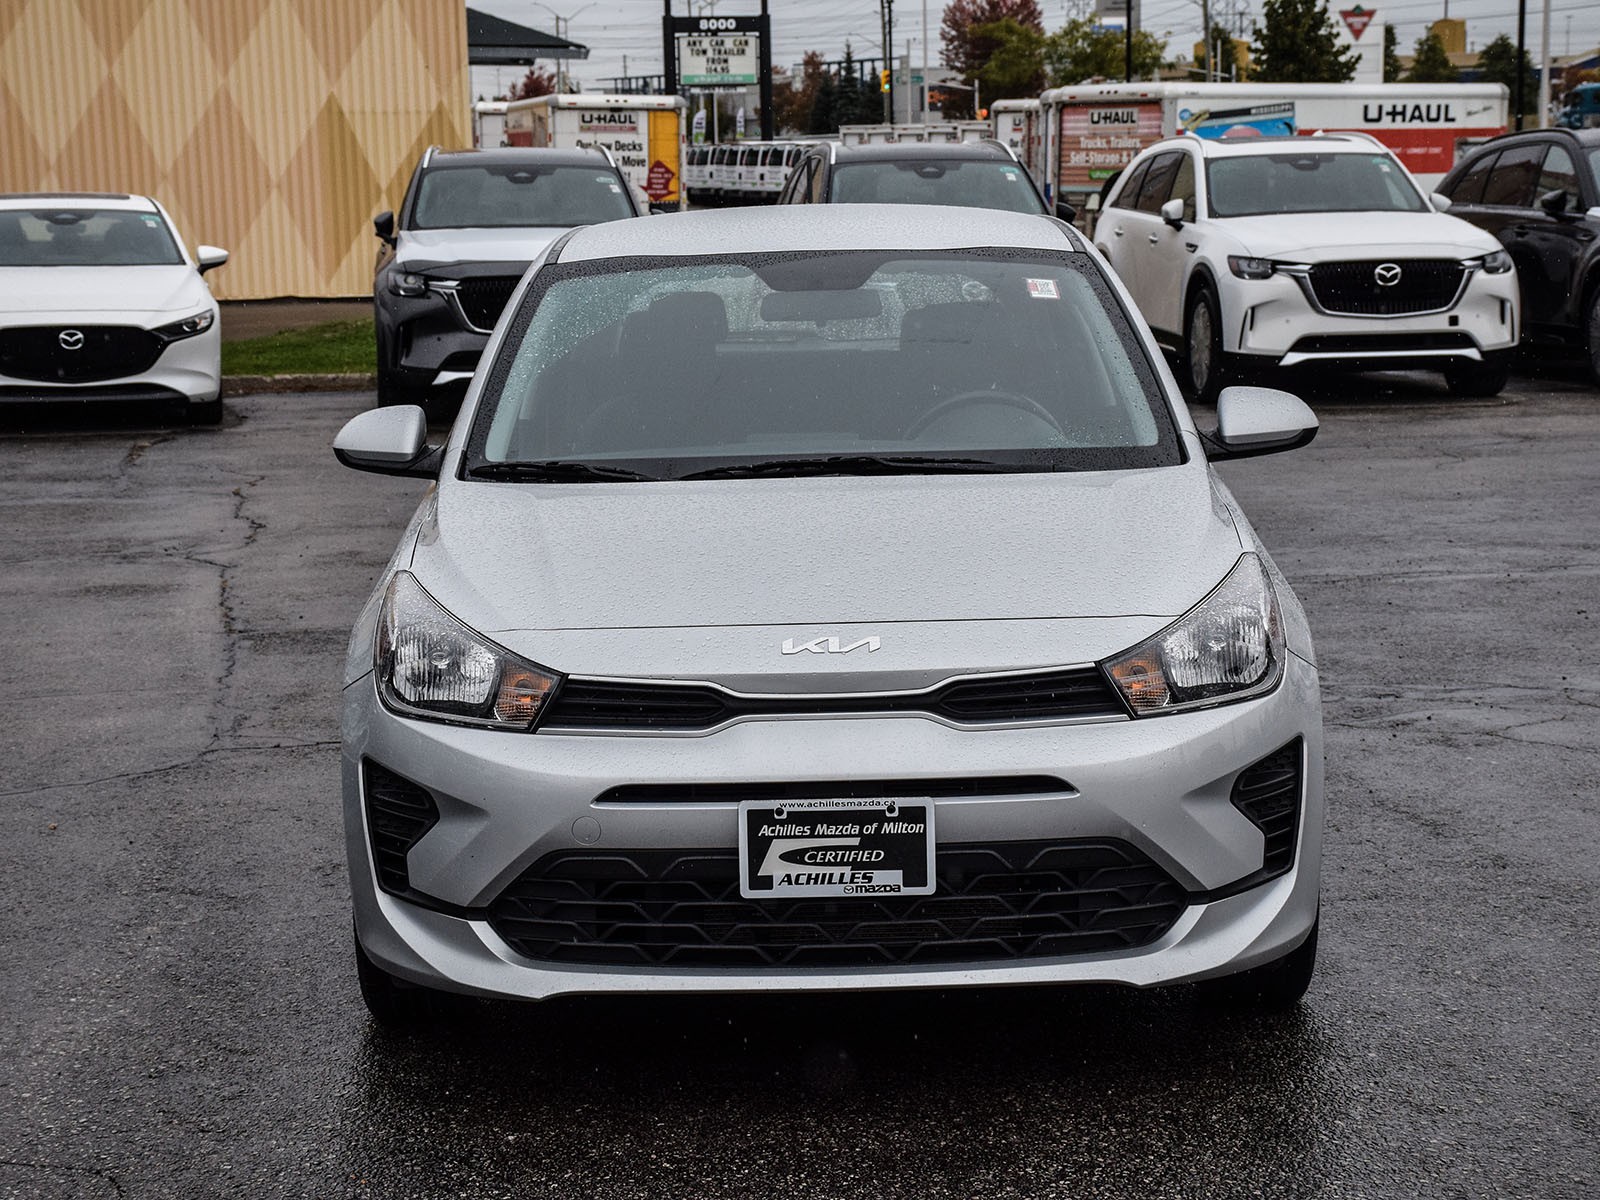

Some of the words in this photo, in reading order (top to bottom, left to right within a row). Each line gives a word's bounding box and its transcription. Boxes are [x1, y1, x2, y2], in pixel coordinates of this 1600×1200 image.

[699, 19, 736, 30] 8000
[687, 39, 702, 47] ANY
[709, 39, 725, 47] CAR
[733, 38, 749, 47] CAN
[690, 48, 707, 56] TOW
[712, 48, 746, 56] TRAILER
[706, 57, 729, 65] FROM
[581, 113, 636, 124] U-HAUL
[1090, 111, 1137, 124] U-HAUL
[1363, 104, 1456, 123] U-HAUL
[614, 140, 643, 152] Decks
[622, 156, 646, 167] Move
[781, 636, 881, 655] KIA
[779, 800, 896, 808] www.achillesmazda.ca
[758, 824, 811, 837] Achilles
[814, 823, 860, 836] Mazda
[863, 822, 879, 835] of
[881, 822, 925, 834] Milton
[804, 850, 885, 863] CERTIFIED
[778, 871, 874, 886] ACHILLES
[855, 884, 901, 893] mazda
